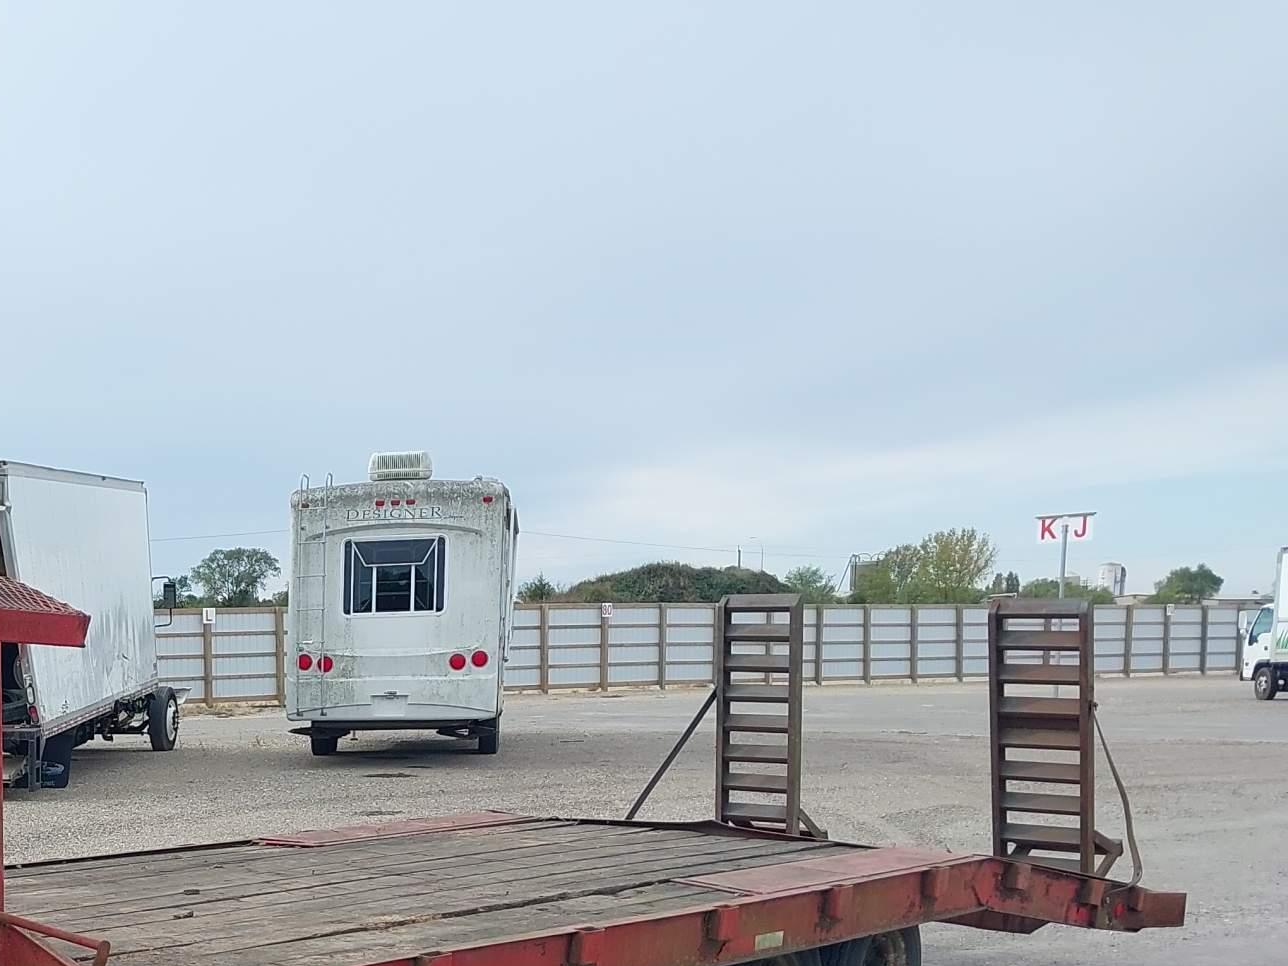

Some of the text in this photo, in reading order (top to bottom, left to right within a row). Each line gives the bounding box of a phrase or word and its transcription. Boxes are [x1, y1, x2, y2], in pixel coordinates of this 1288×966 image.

[346, 506, 442, 520] DESIGNER
[1040, 515, 1087, 540] K J
